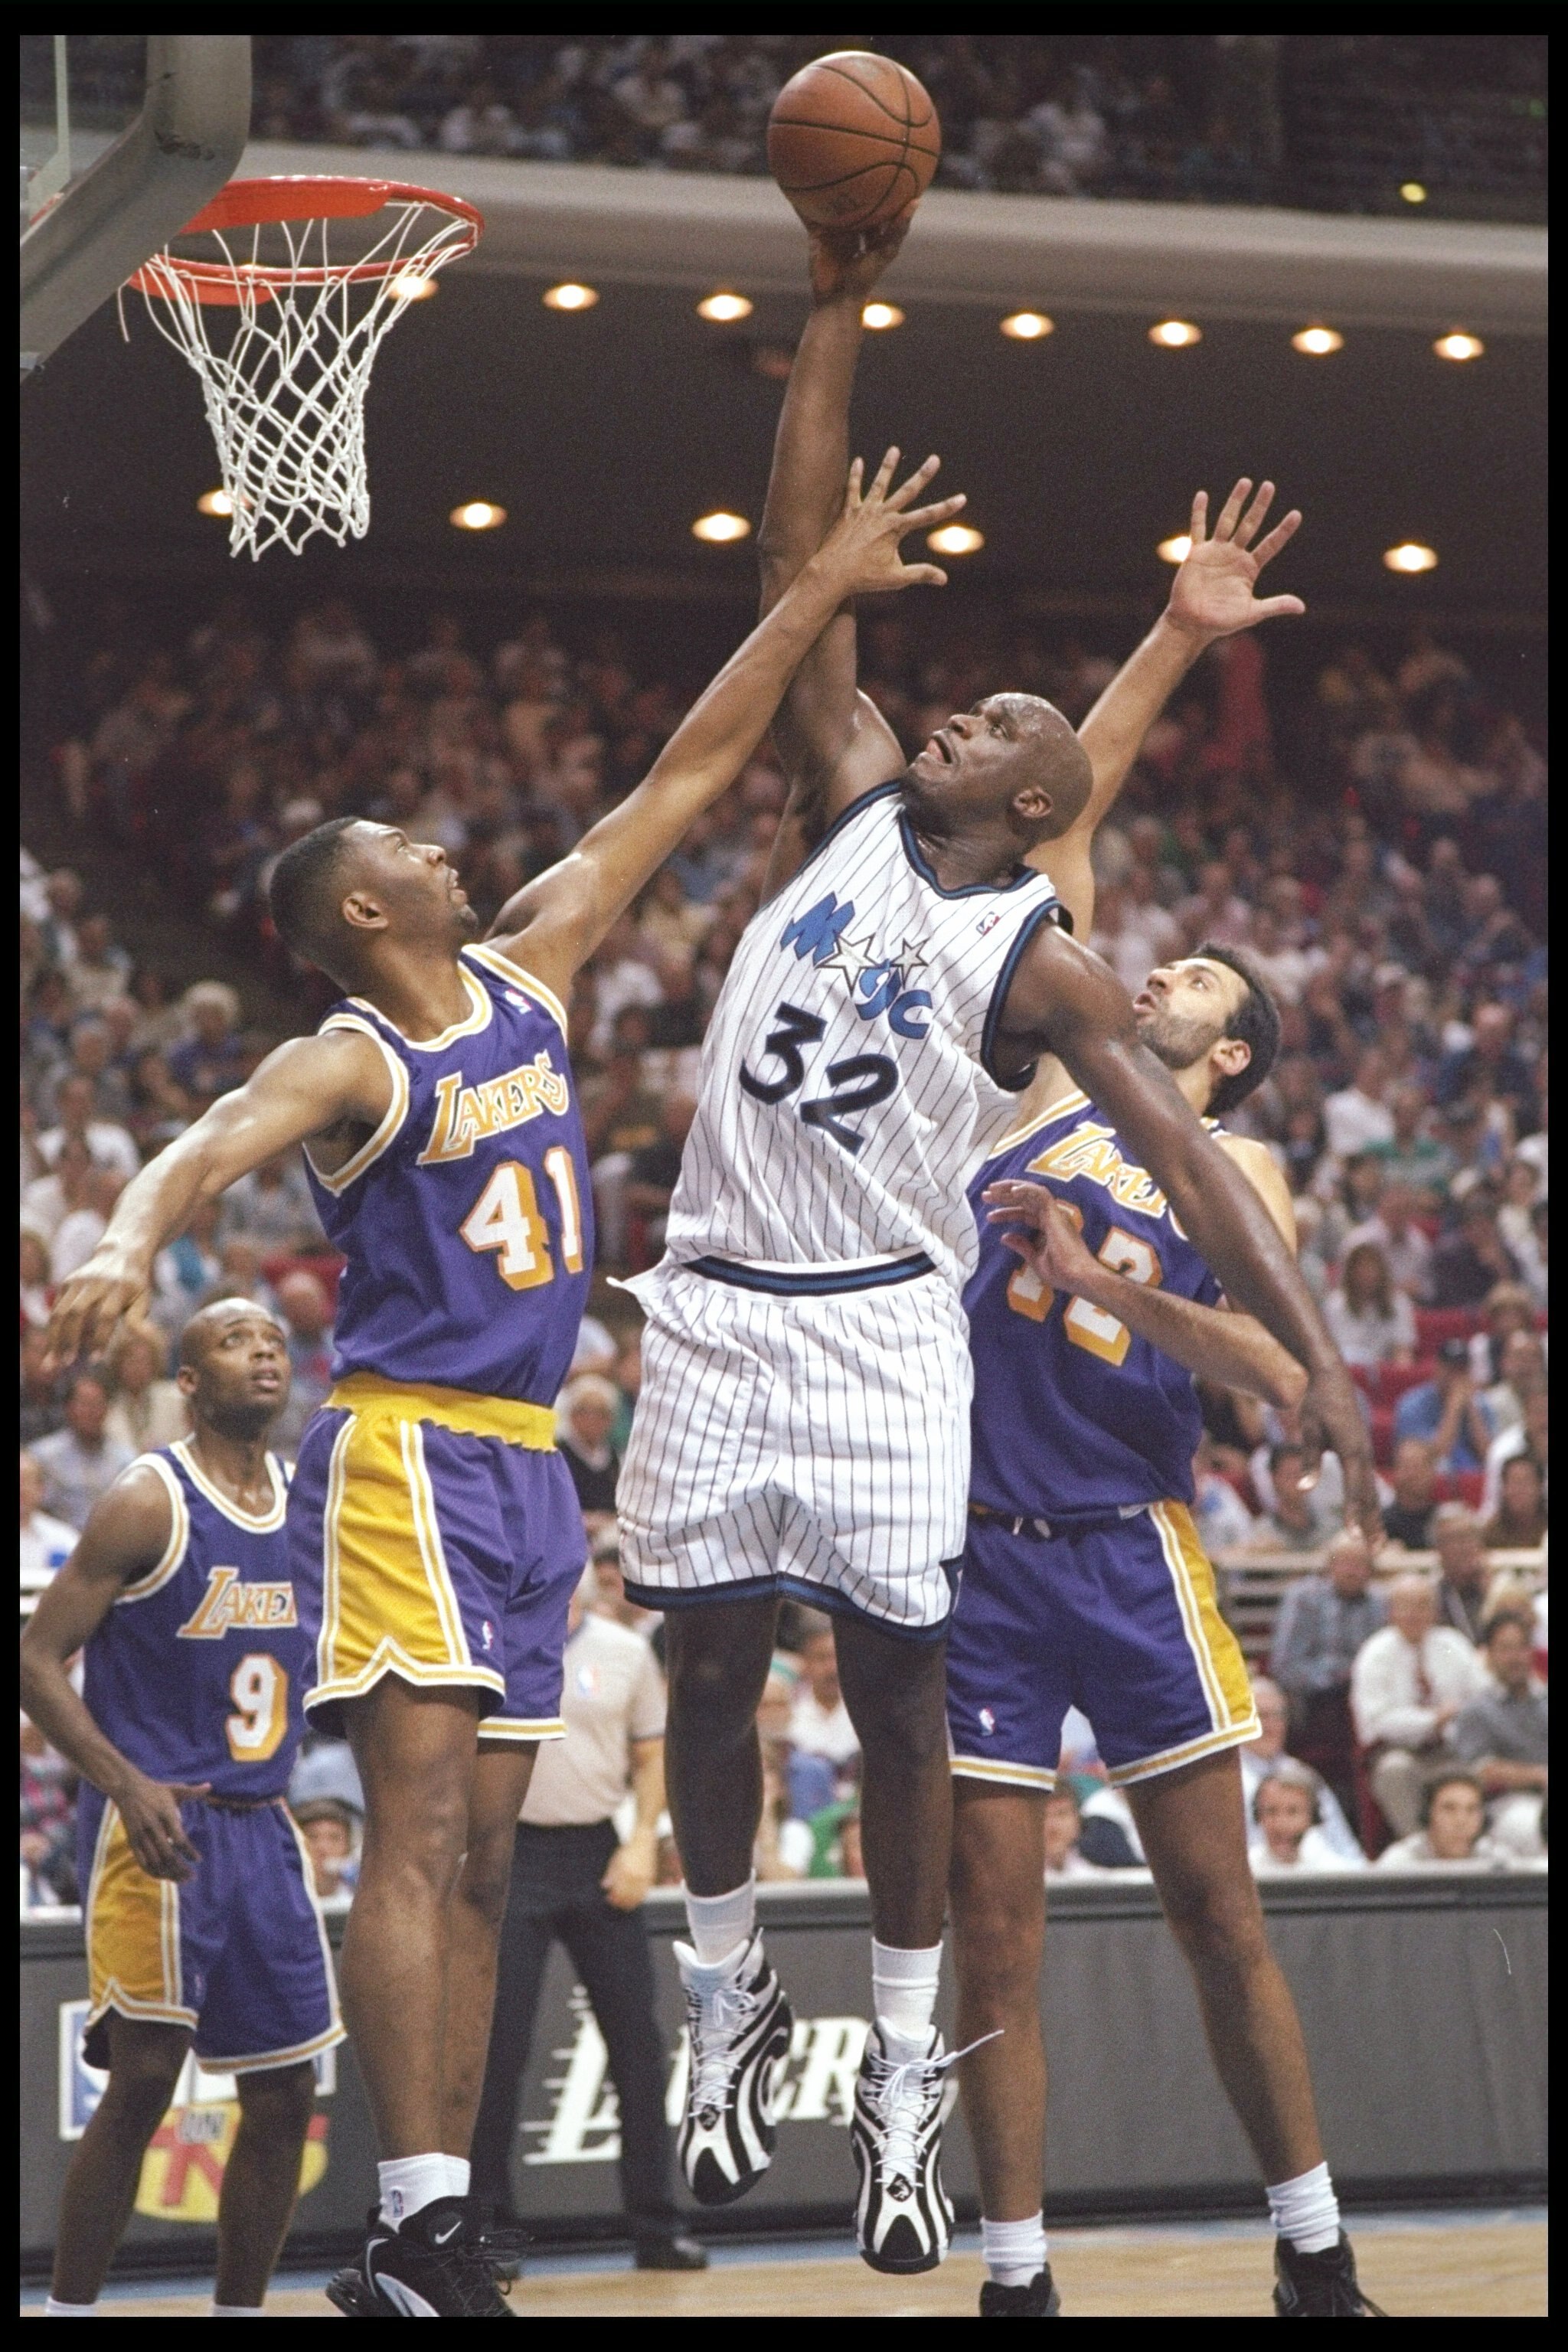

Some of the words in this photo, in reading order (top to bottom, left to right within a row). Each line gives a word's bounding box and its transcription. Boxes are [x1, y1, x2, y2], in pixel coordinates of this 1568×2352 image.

[416, 1049, 569, 1165] LAKERS
[739, 1001, 899, 1155] 32
[459, 1145, 584, 1292] 41
[1024, 1120, 1168, 1219] LAKE
[175, 1566, 298, 1639] LAKE
[225, 1653, 289, 1762] 9
